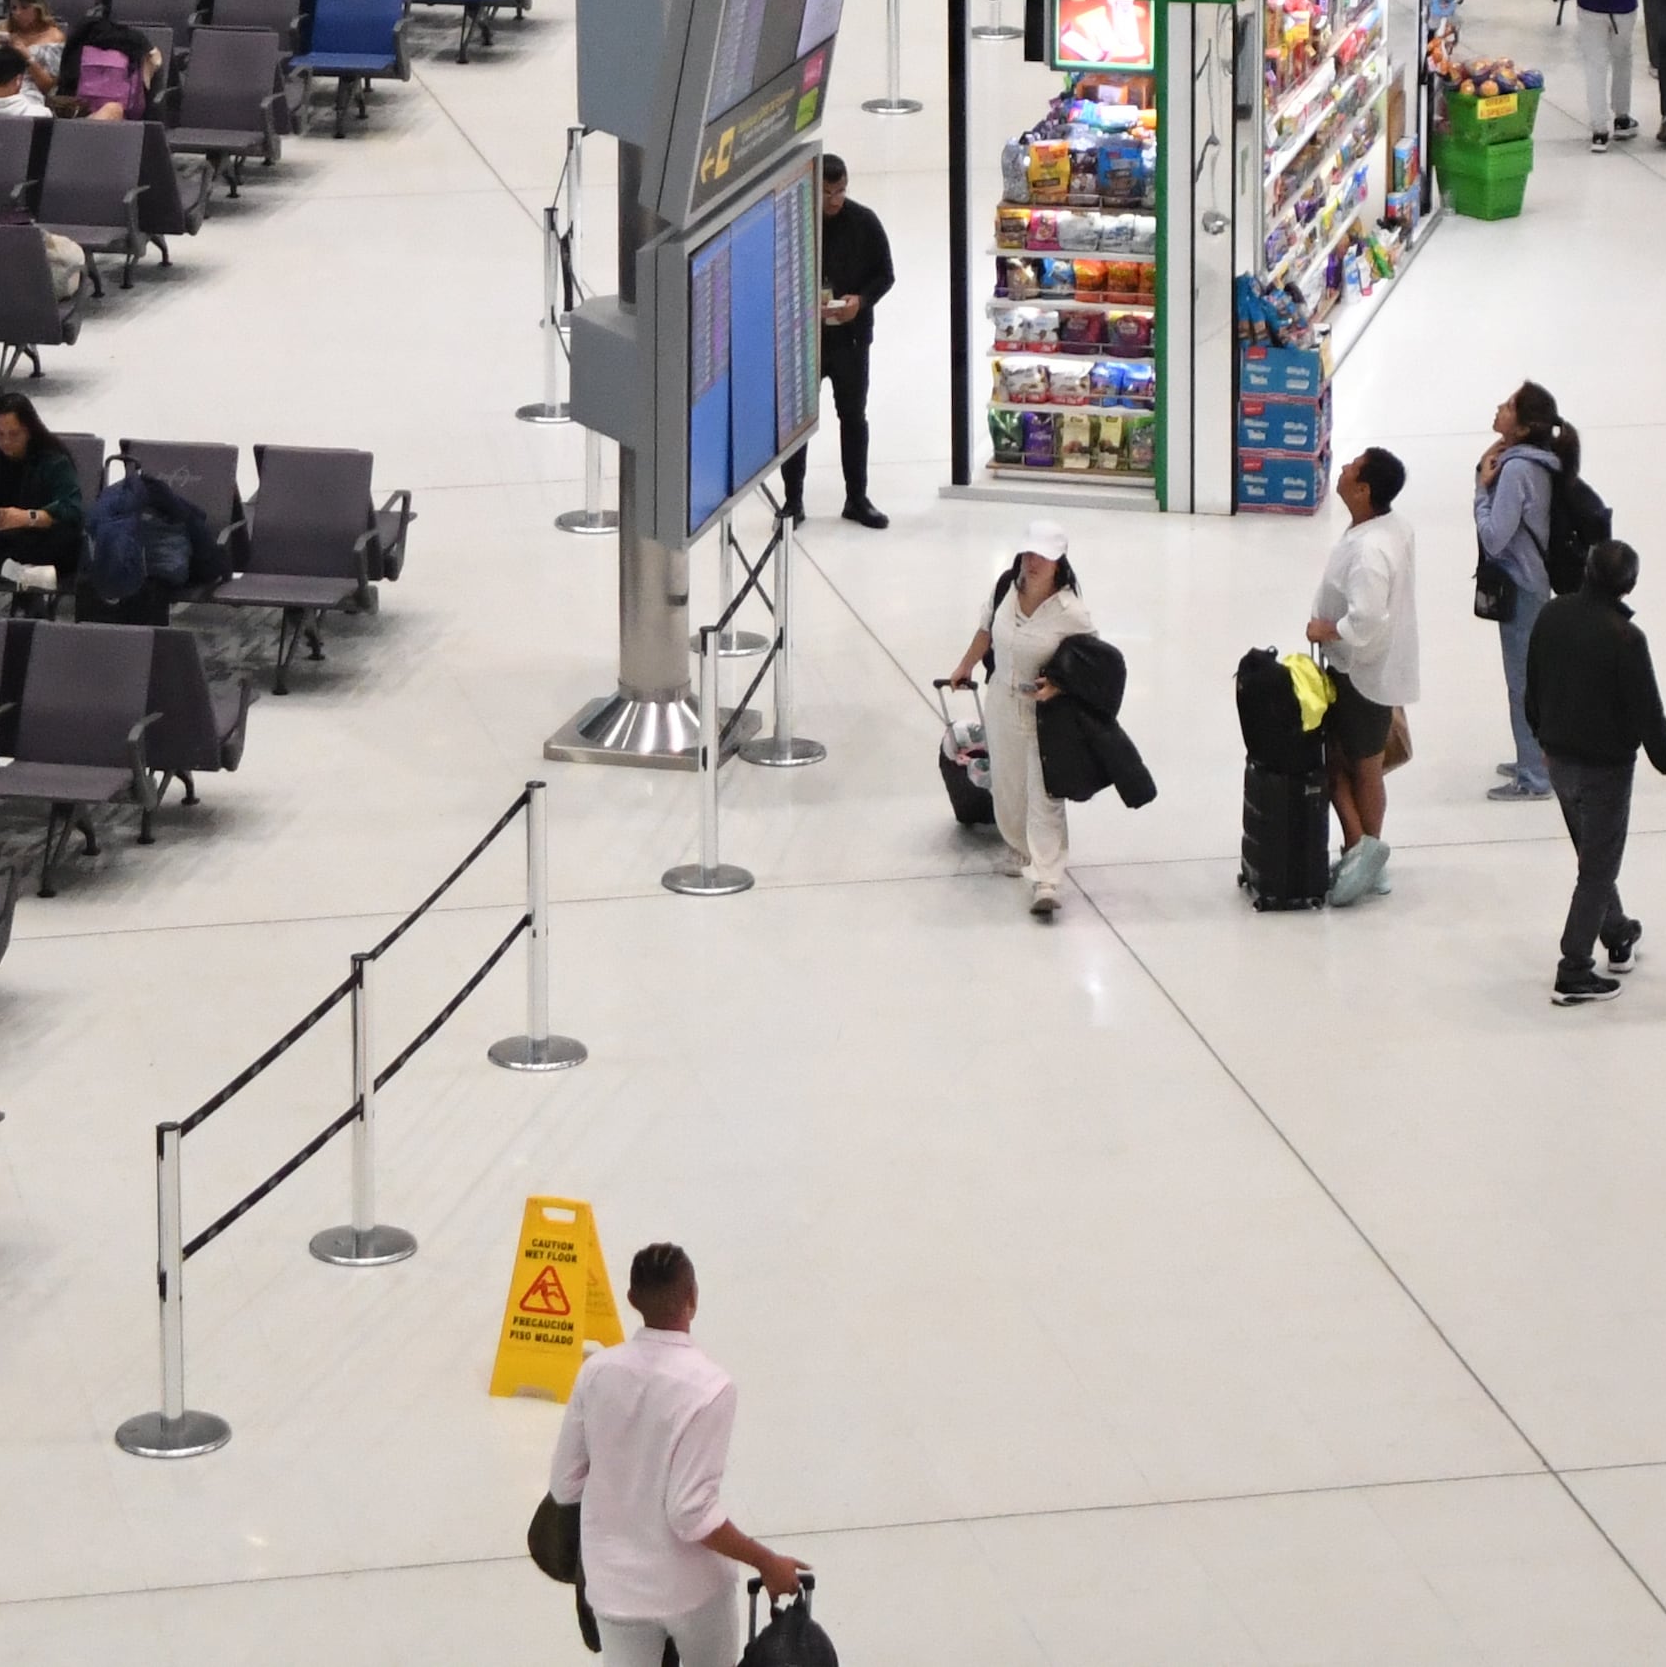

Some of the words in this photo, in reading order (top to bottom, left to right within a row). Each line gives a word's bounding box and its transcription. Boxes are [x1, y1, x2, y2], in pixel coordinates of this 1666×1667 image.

[532, 1238, 574, 1250] CAUTION
[525, 1250, 544, 1259] WET
[547, 1251, 577, 1262] FLOOR
[513, 1316, 574, 1330] PRECAUCIÓN
[510, 1331, 531, 1341] PISO
[535, 1332, 573, 1345] MOJADO
